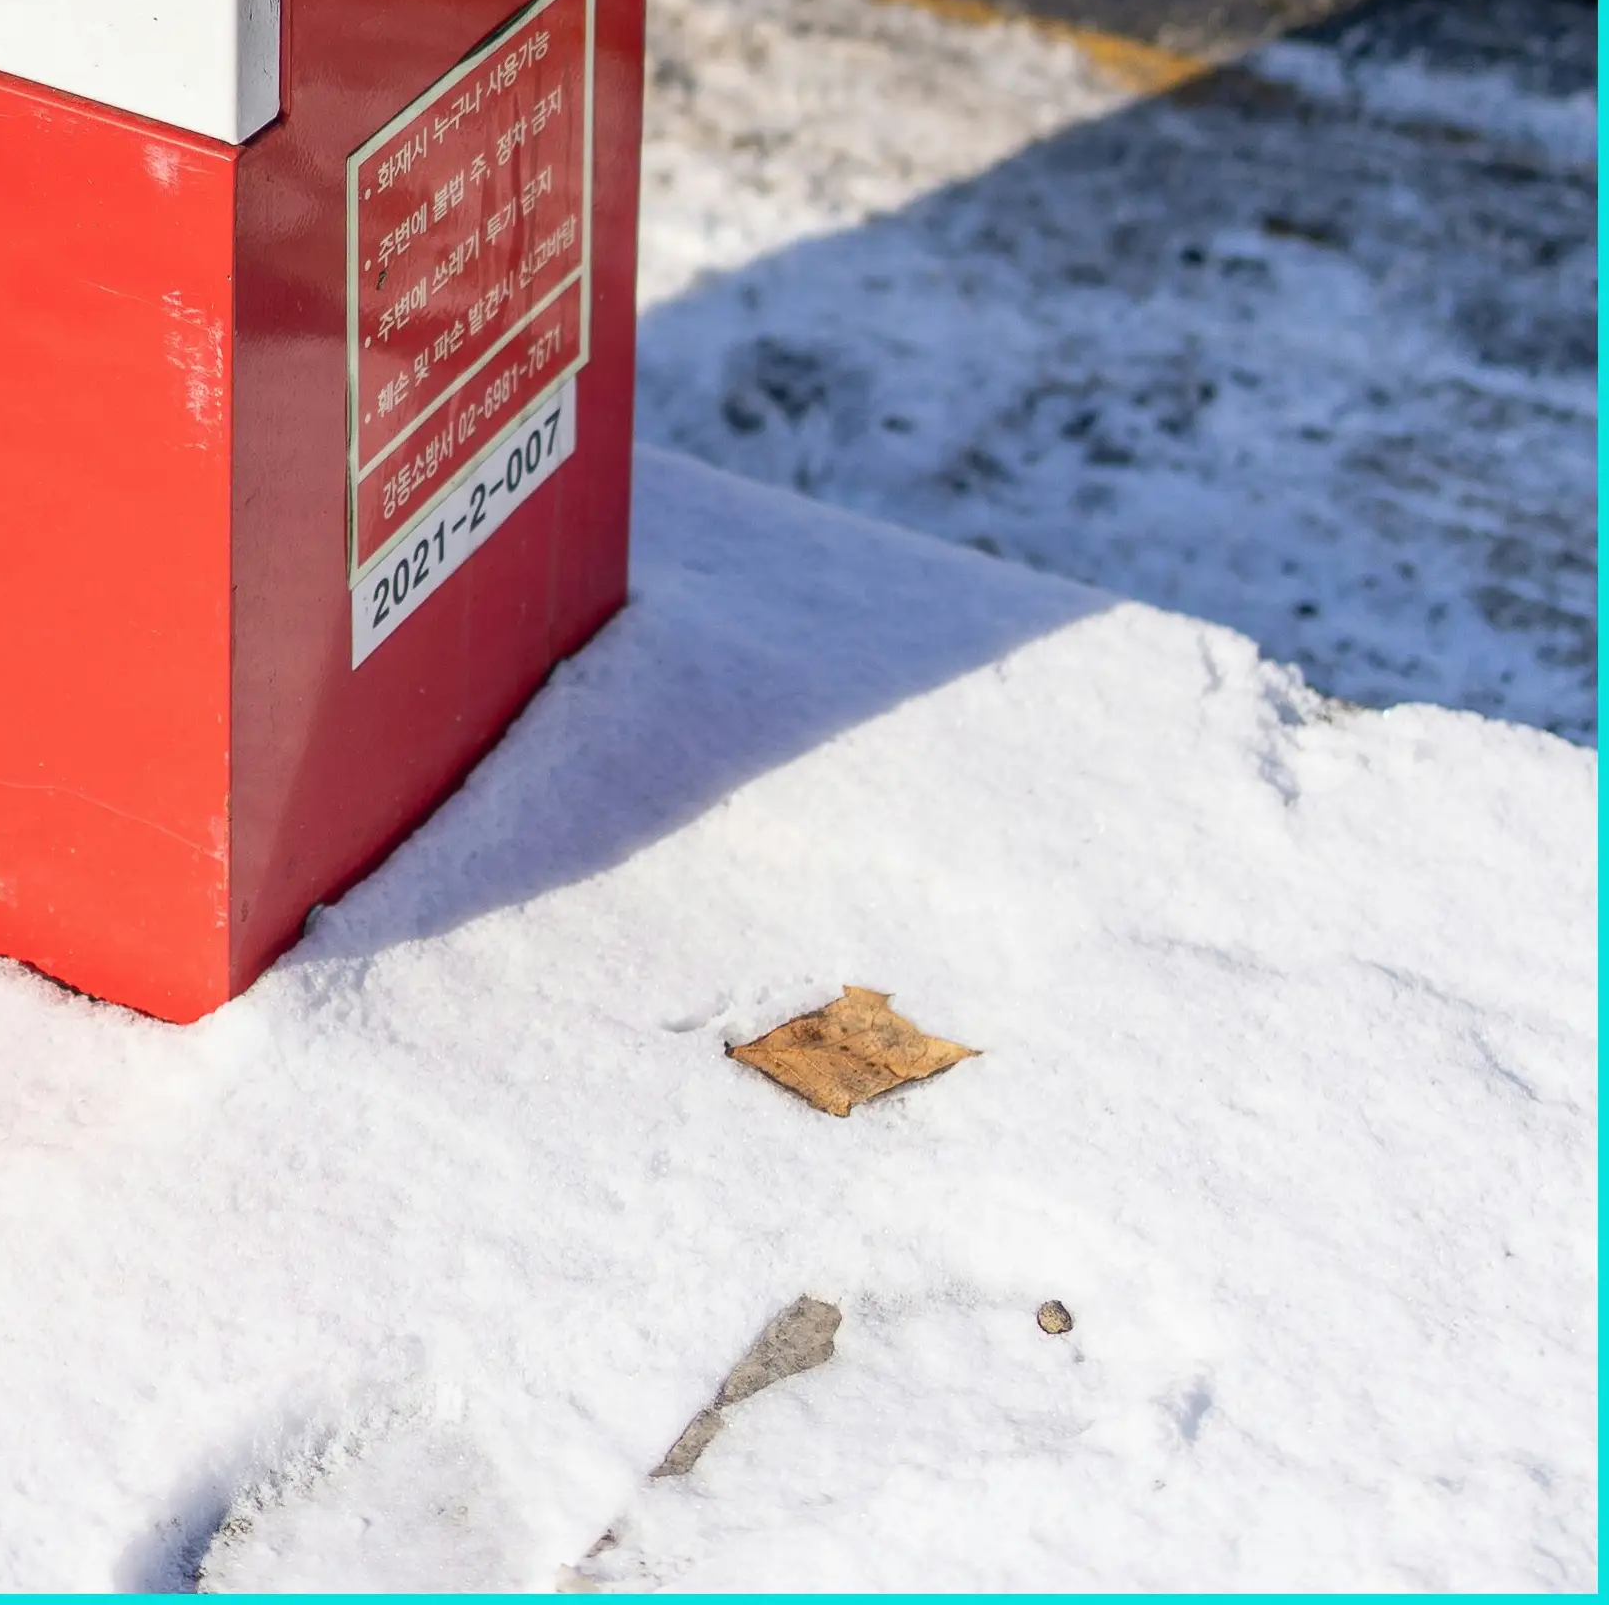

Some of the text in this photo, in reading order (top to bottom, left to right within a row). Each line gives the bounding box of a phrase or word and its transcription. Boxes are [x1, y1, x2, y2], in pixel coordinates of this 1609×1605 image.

[377, 29, 551, 193] 화재시 누구나 사용가능
[377, 202, 427, 269] 주변에
[432, 167, 465, 220] 불법
[496, 116, 527, 168] 정차
[531, 85, 563, 137] 금지
[377, 165, 553, 342] 주변에 쓰레기 투기 금지
[377, 213, 579, 417] 훼손 및 파손 발견시 신고바람
[382, 324, 564, 520] 강동소방서 02-6981-7671
[372, 408, 562, 630] 2021-2-007
